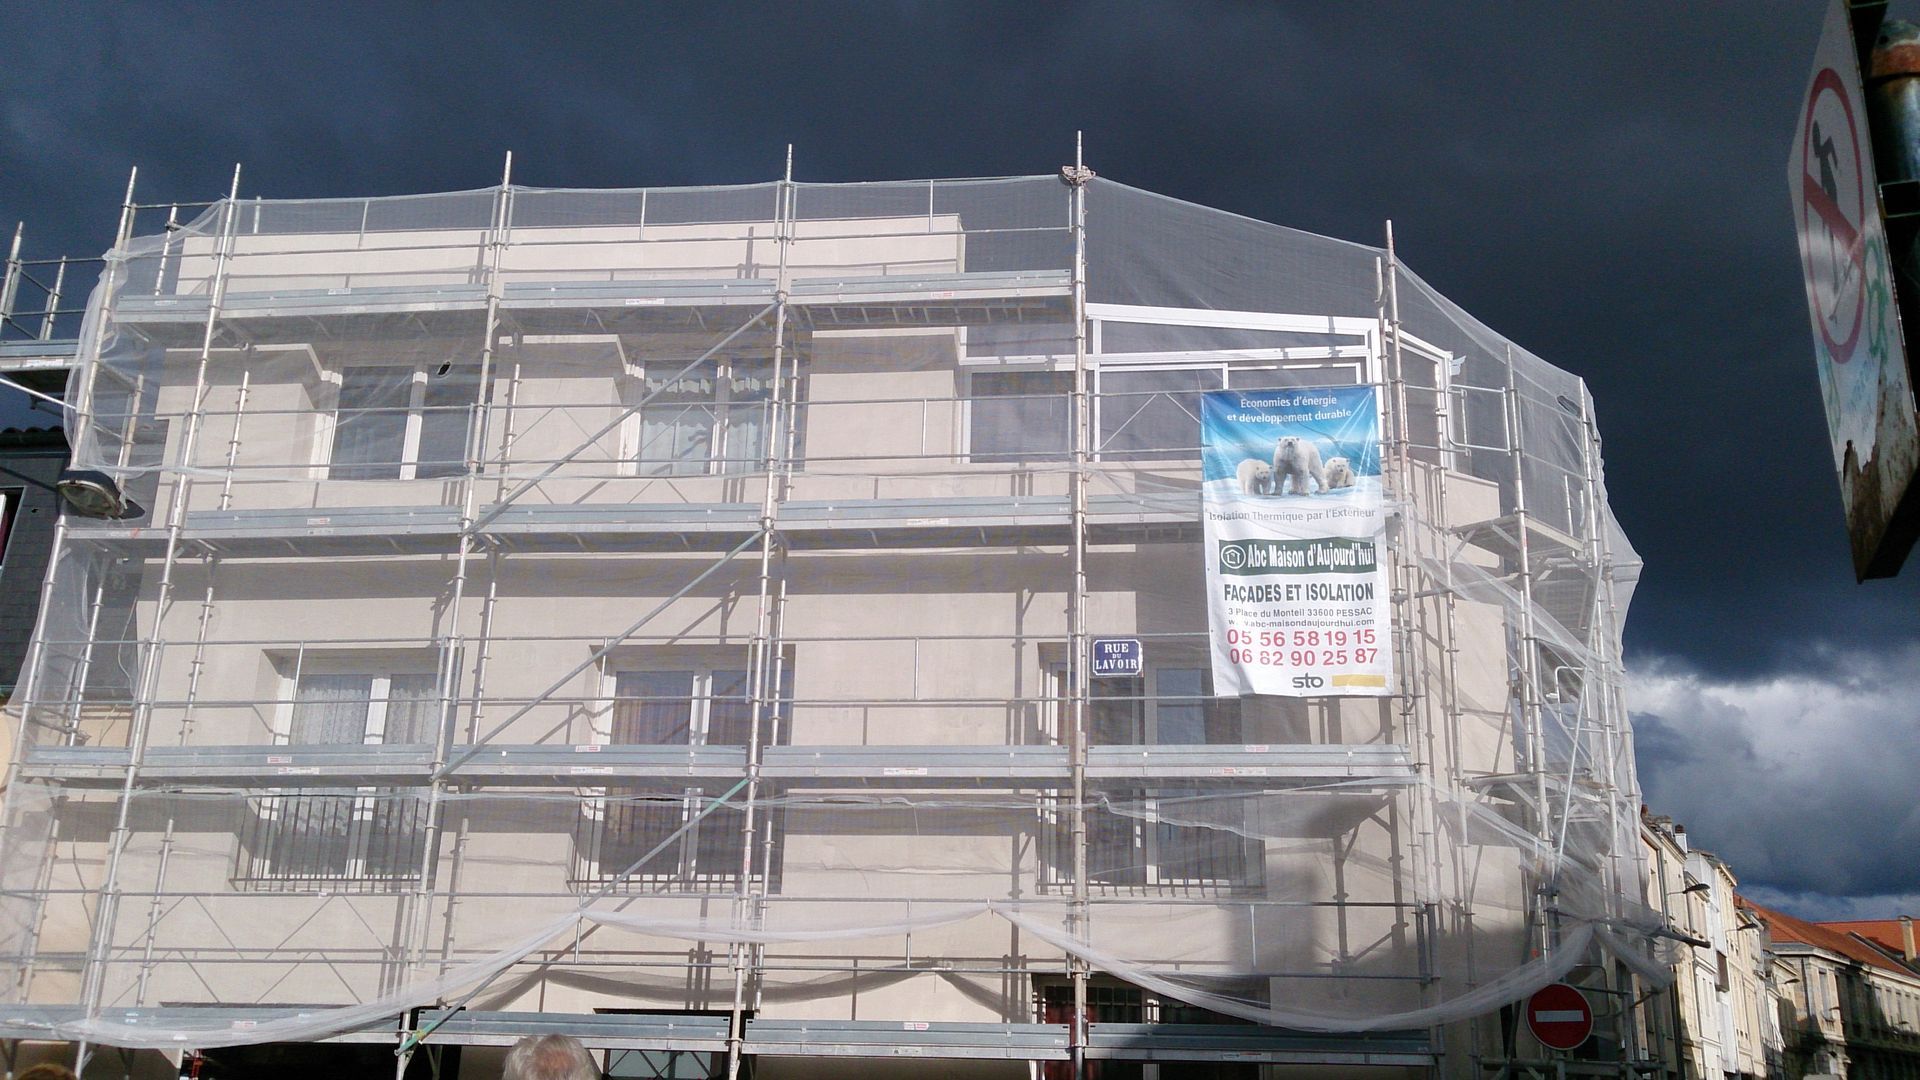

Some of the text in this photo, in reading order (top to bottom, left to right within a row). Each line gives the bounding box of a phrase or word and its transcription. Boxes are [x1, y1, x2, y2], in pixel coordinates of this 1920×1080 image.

[1240, 395, 1337, 408] Economies d'énergie
[1227, 409, 1352, 424] et développement durable
[1209, 508, 1376, 522] Isolation Thermique par l'Extérieur
[1247, 542, 1375, 570] Abc Maison d'Aujourd'hui
[1224, 582, 1374, 604] FAÇADES ET ISOLATION
[1235, 607, 1258, 618] Place
[1261, 609, 1271, 618] du
[1307, 608, 1334, 617] 33600
[1336, 607, 1373, 617] PESSAC
[1227, 629, 1376, 647] 05 56 58 19 15
[1104, 643, 1129, 653] RUE
[1095, 659, 1137, 670] LAVOIR
[1230, 648, 1378, 666] 06 82 90 25 87
[1291, 672, 1324, 689] sto
